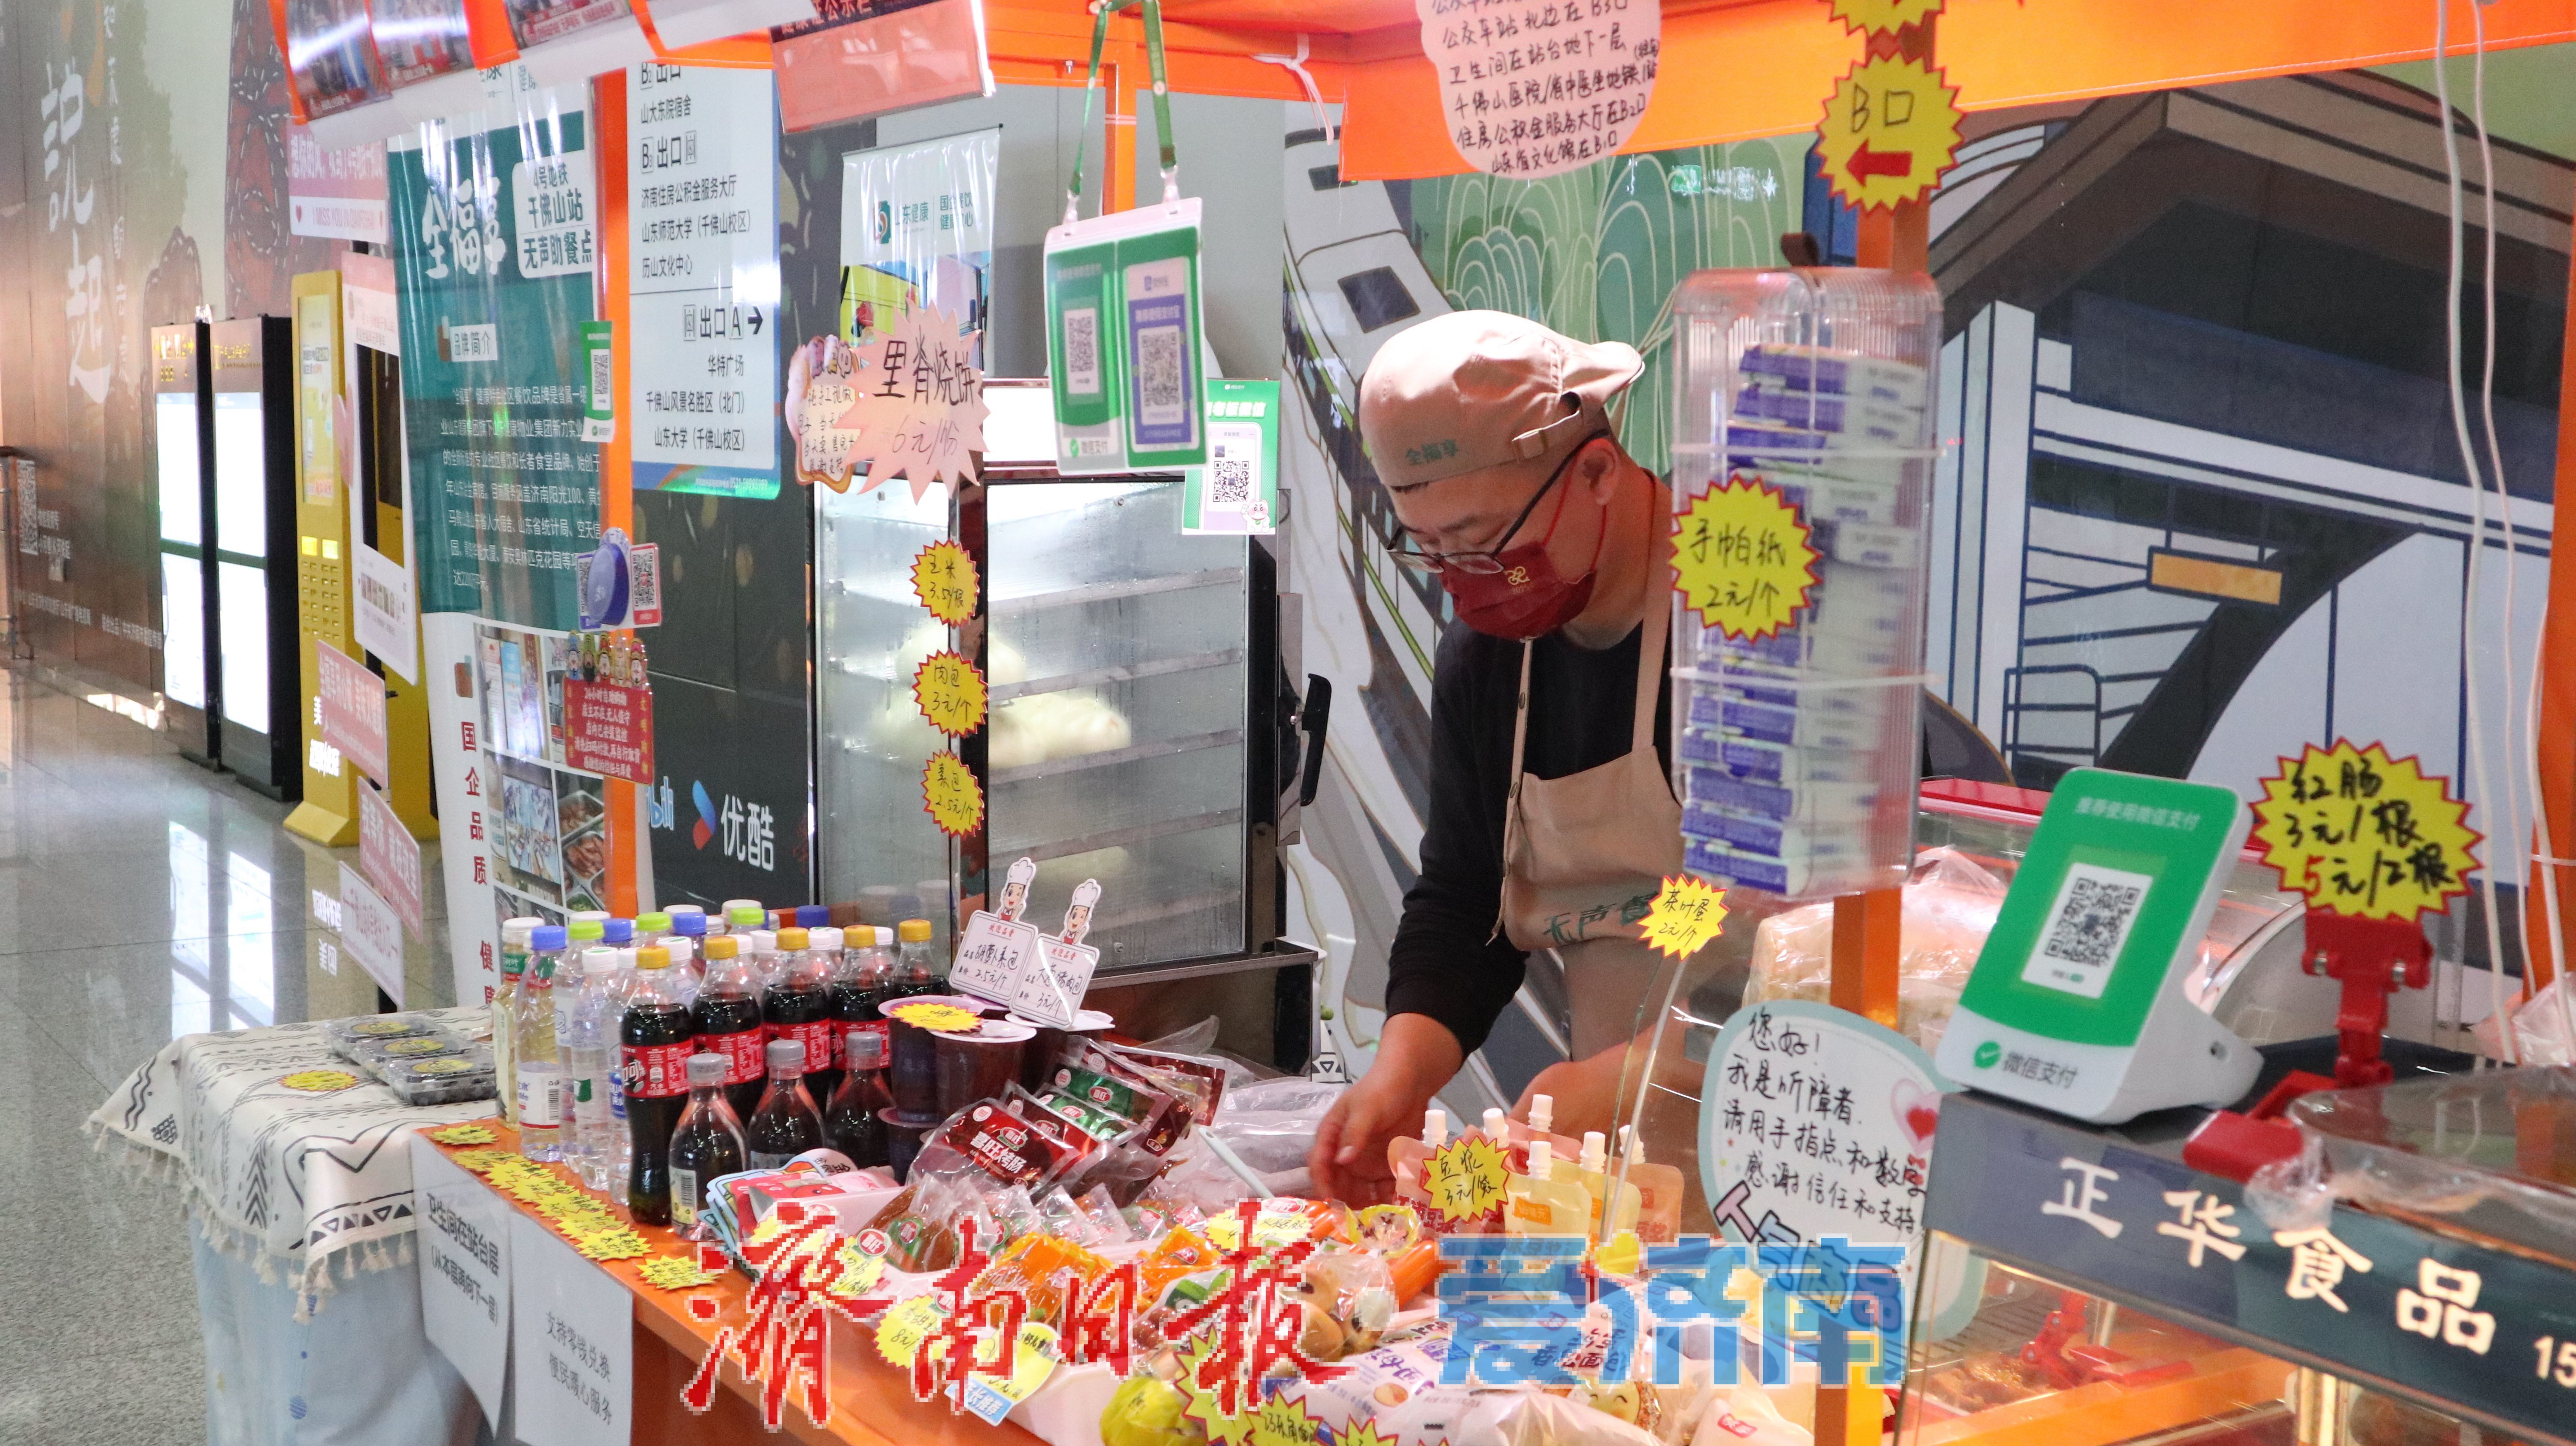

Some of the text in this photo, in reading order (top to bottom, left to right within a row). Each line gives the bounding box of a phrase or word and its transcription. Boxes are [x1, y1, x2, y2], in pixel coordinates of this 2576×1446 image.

[641, 95, 692, 124] 山大东院宿舍
[1851, 83, 1914, 133] B口
[657, 137, 681, 169] 出口
[534, 164, 569, 189] 4号地铁
[641, 175, 737, 209] 济南住房公积金服务大厅
[529, 188, 583, 230] 千佛山站
[523, 231, 592, 270] 无声助餐点
[642, 256, 692, 279] 历山文化中心
[700, 306, 726, 338] 出口
[454, 331, 491, 356] 品牌简介
[708, 355, 744, 377] 华特广场
[872, 325, 975, 406] 里脊烧饼
[892, 415, 960, 465] 6元/份
[1690, 518, 1786, 567] 手帕纸
[1706, 582, 1780, 617] 2元/个
[934, 665, 960, 687] 肉包
[933, 691, 972, 723] 3元/个
[2290, 757, 2384, 803] 红肠
[461, 720, 489, 886] 国企品质
[721, 794, 774, 872] 优酷
[2284, 799, 2424, 849] 3元/根
[2305, 842, 2454, 908] 5元/2根
[1663, 889, 1710, 923] 茶叶蛋
[1658, 922, 1698, 947] 2元/个
[2002, 1051, 2078, 1089] 微信支付
[970, 1131, 1027, 1174] 喜旺烤肠
[1440, 1149, 1483, 1182] 豆浆
[2041, 1156, 2496, 1356] 正华食品
